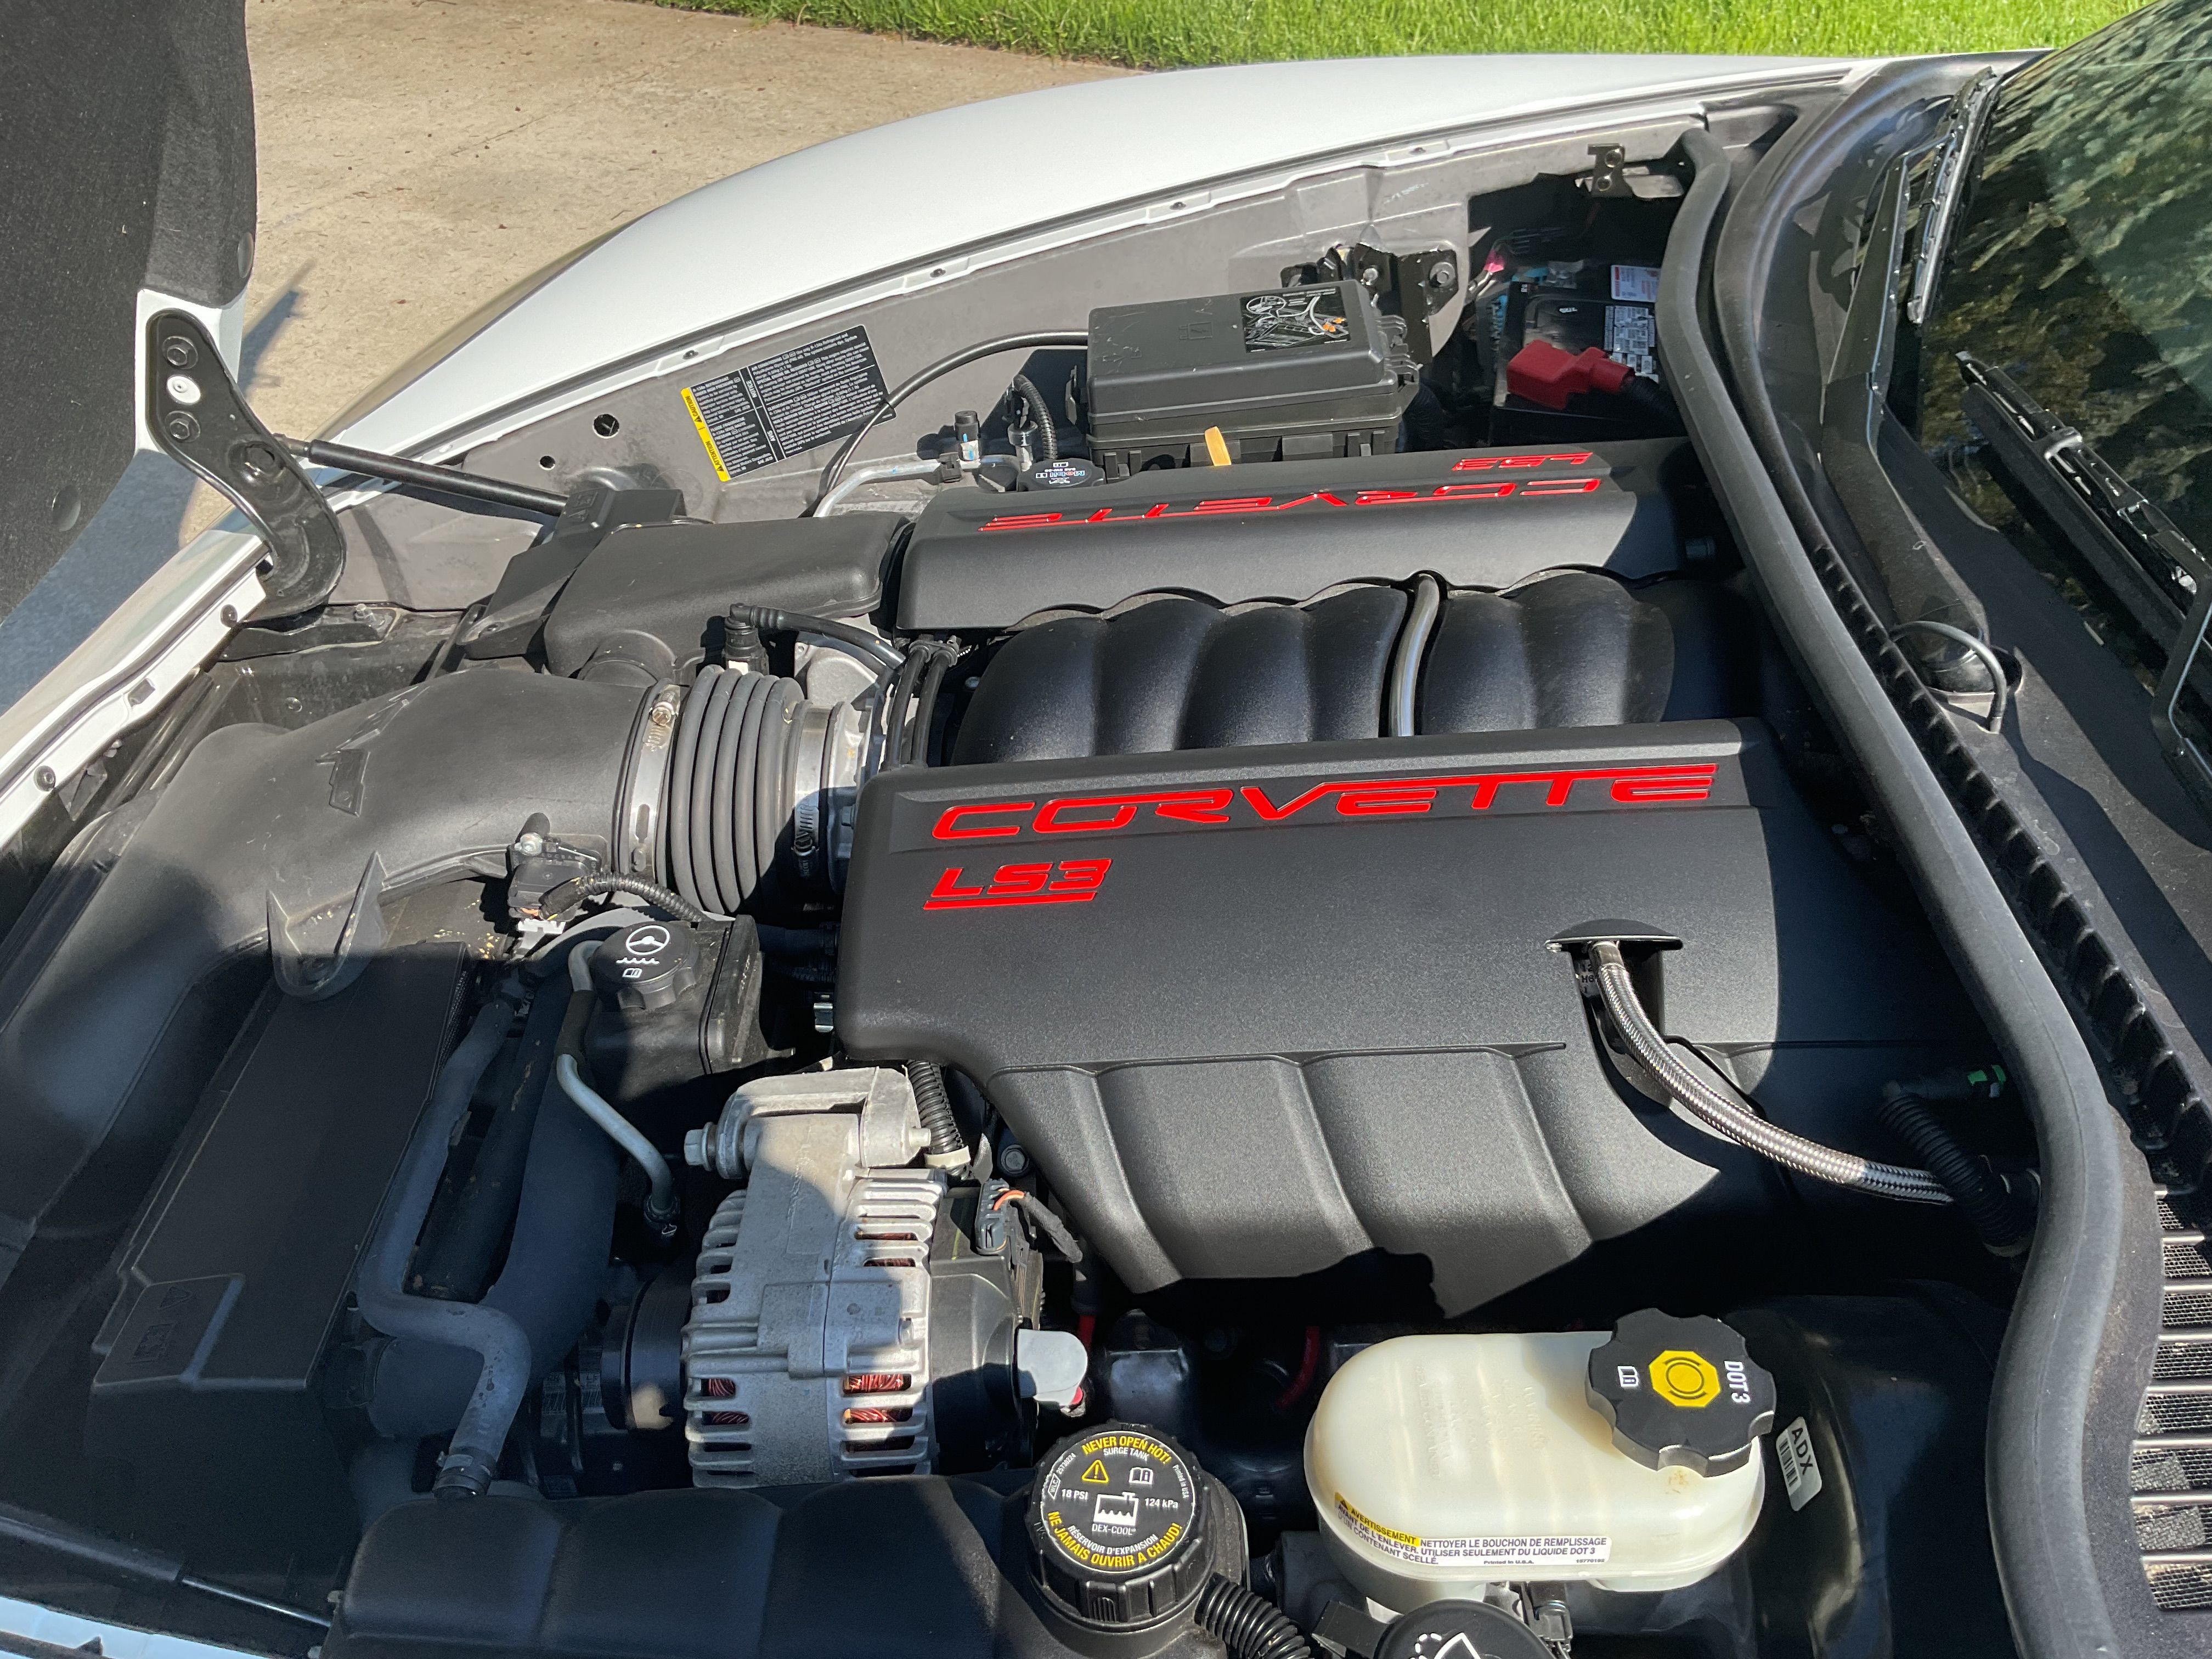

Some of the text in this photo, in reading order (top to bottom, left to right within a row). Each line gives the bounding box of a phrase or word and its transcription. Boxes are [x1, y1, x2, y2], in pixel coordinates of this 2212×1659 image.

[747, 380, 757, 399] NOTICE
[685, 395, 698, 416] CAUTION
[768, 431, 776, 441] AVIS
[706, 441, 720, 466] ATTENTION
[978, 478, 1601, 531] CORVETTE
[932, 764, 1716, 839] CORVETTE
[932, 857, 1113, 900] LS3
[1724, 1361, 1751, 1403] DOT 3
[1056, 1453, 1076, 1474] 25730224
[1082, 1435, 1172, 1465] NEVER OPEN HOT!
[1103, 1447, 1150, 1462] SURGE TANK
[1791, 1427, 1813, 1475] ADX
[1050, 1479, 1058, 1492] WLC
[1172, 1464, 1186, 1481] Printed
[1062, 1489, 1088, 1500] 18 PSI
[1144, 1498, 1178, 1509] 124 kPa
[1048, 1511, 1061, 1526] NE
[1055, 1523, 1088, 1560] JAMAIS
[1091, 1553, 1135, 1567] OUVRIR
[1147, 1522, 1183, 1559] CHAUD!
[1068, 1525, 1105, 1554] RÉSERVOIR
[1107, 1534, 1158, 1555] D'EXPANSION
[1338, 1504, 1358, 1527] AVANT
[1359, 1523, 1370, 1534] DE
[1372, 1531, 1419, 1554] L'ENLEVER.
[1421, 1548, 1460, 1556] UTILISER
[1462, 1548, 1516, 1556] SEULEMENT
[1351, 1508, 1607, 1548] AVERTISSEMENT NETTOYER LE BOUCHON DE REMPLISSAGE
[1353, 1527, 1401, 1558] CONTENANT
[1403, 1552, 1438, 1565] SCELLÉ.
